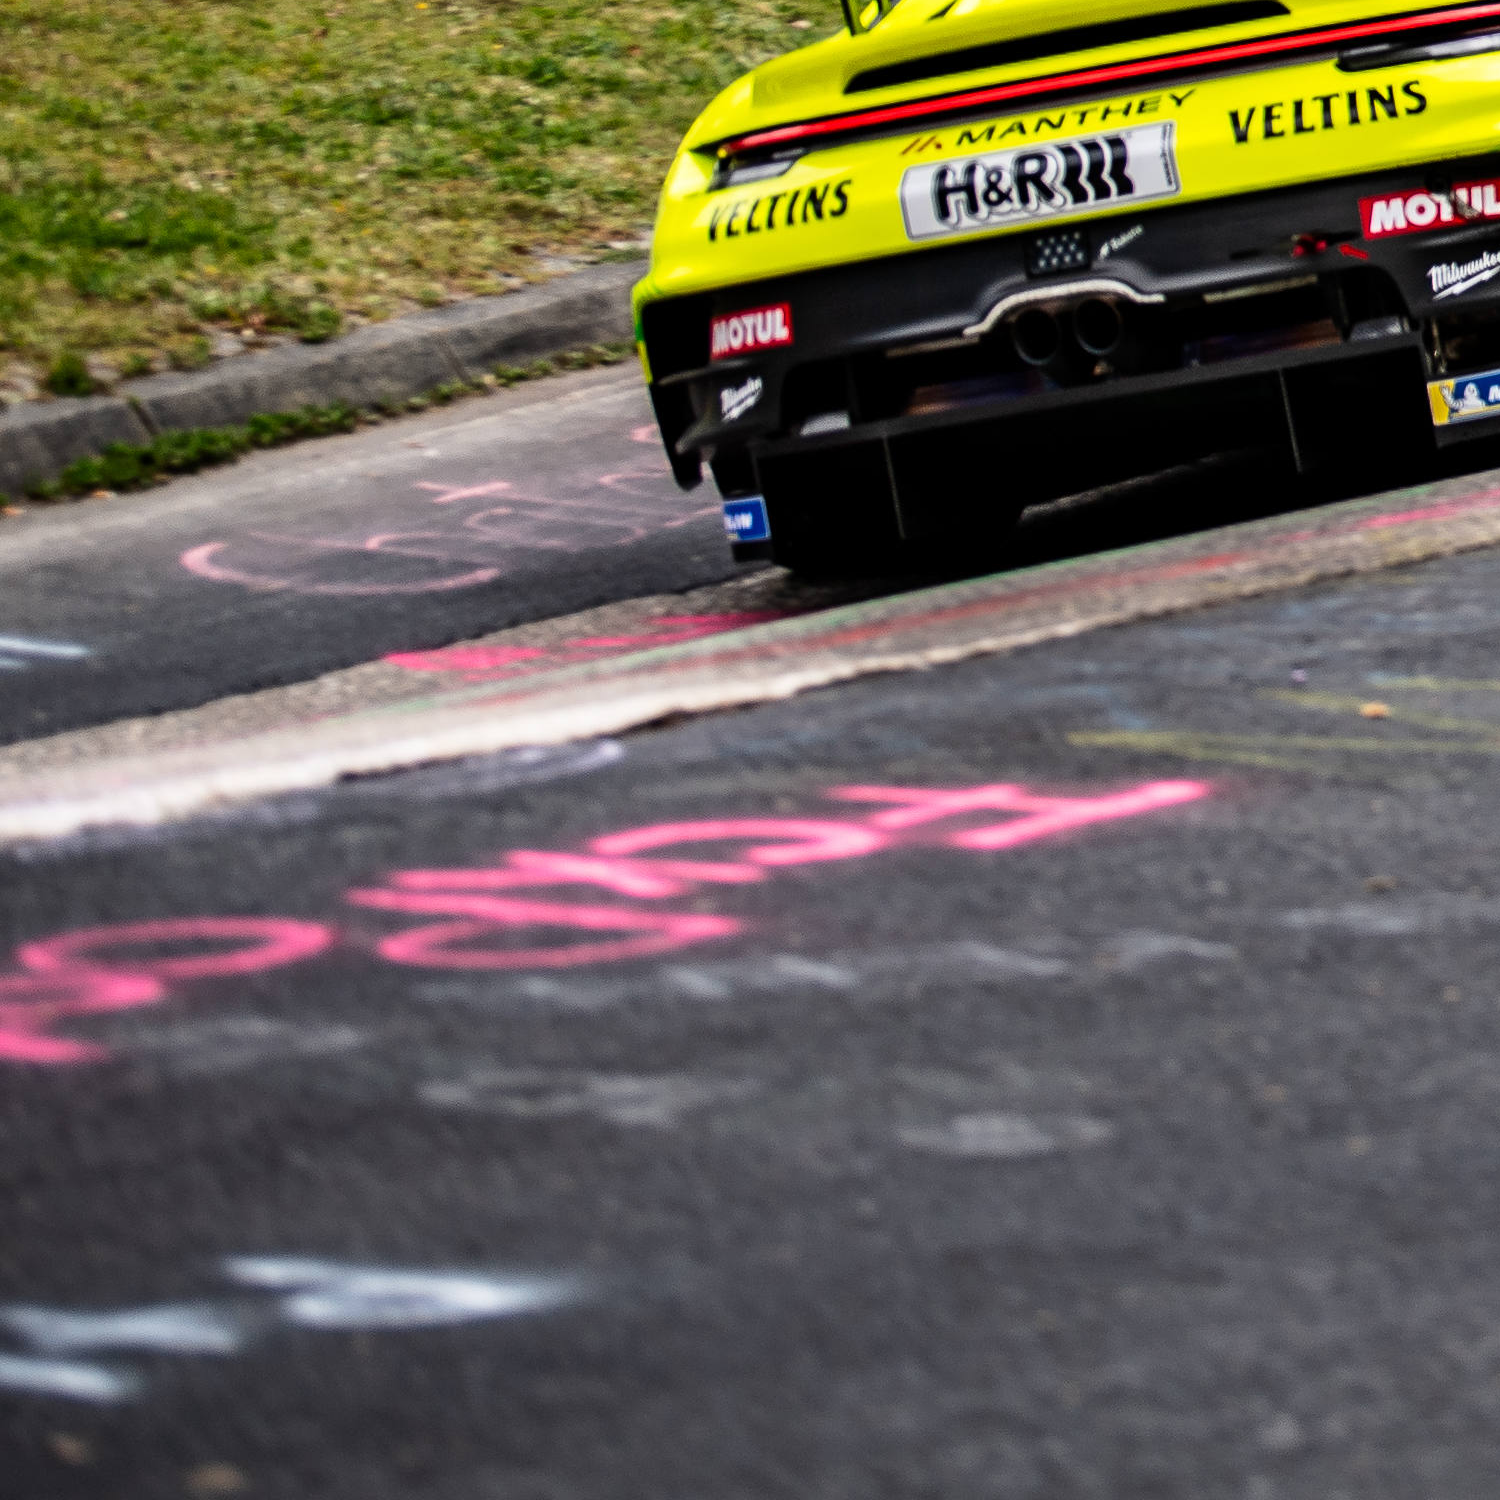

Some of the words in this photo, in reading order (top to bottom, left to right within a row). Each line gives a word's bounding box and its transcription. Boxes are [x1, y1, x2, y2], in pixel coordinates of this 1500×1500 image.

[956, 88, 1198, 147] MANTHEY
[1228, 79, 1429, 144] VELTINS
[708, 179, 854, 242] VELTINS
[711, 306, 790, 357] MOTUL
